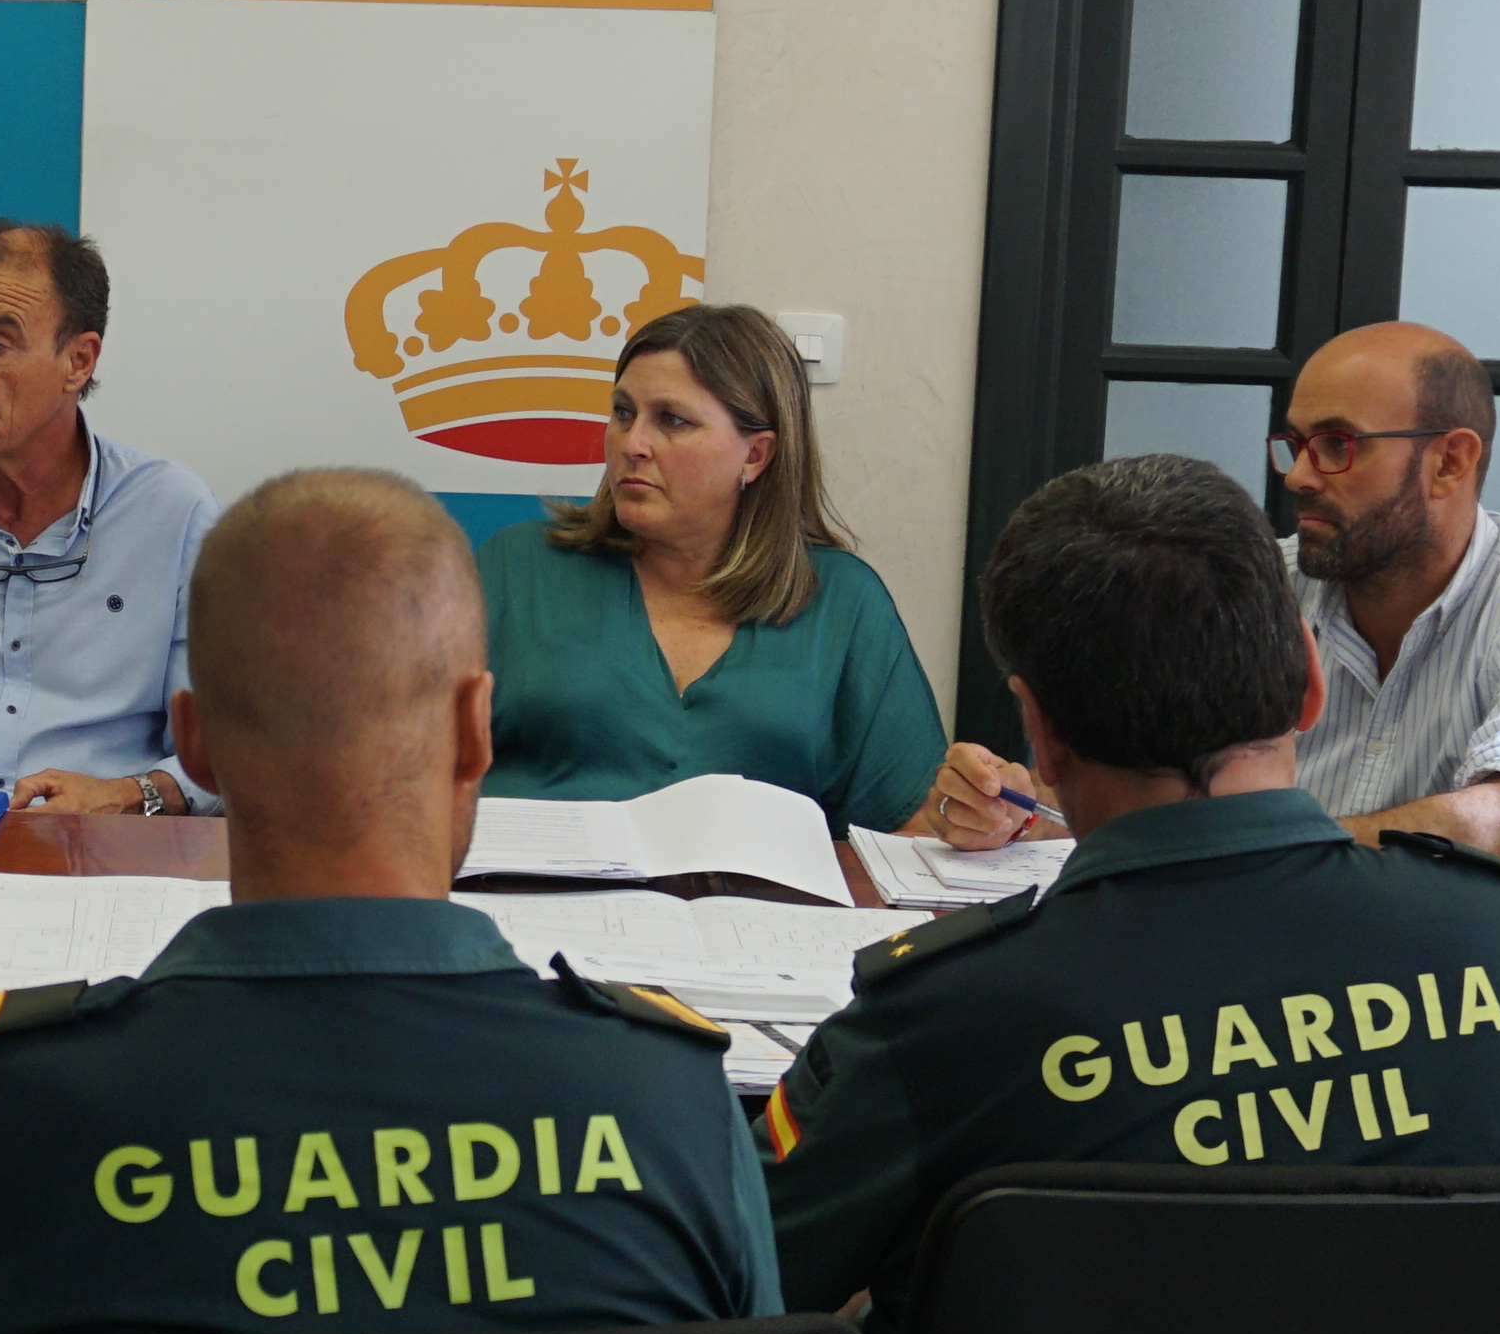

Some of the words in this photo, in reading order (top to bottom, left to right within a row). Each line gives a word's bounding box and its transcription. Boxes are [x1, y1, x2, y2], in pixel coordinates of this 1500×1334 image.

[1172, 1067, 1431, 1166] CIVIL
[93, 1113, 644, 1224] GUARDIA
[234, 1222, 537, 1318] CIVIL
